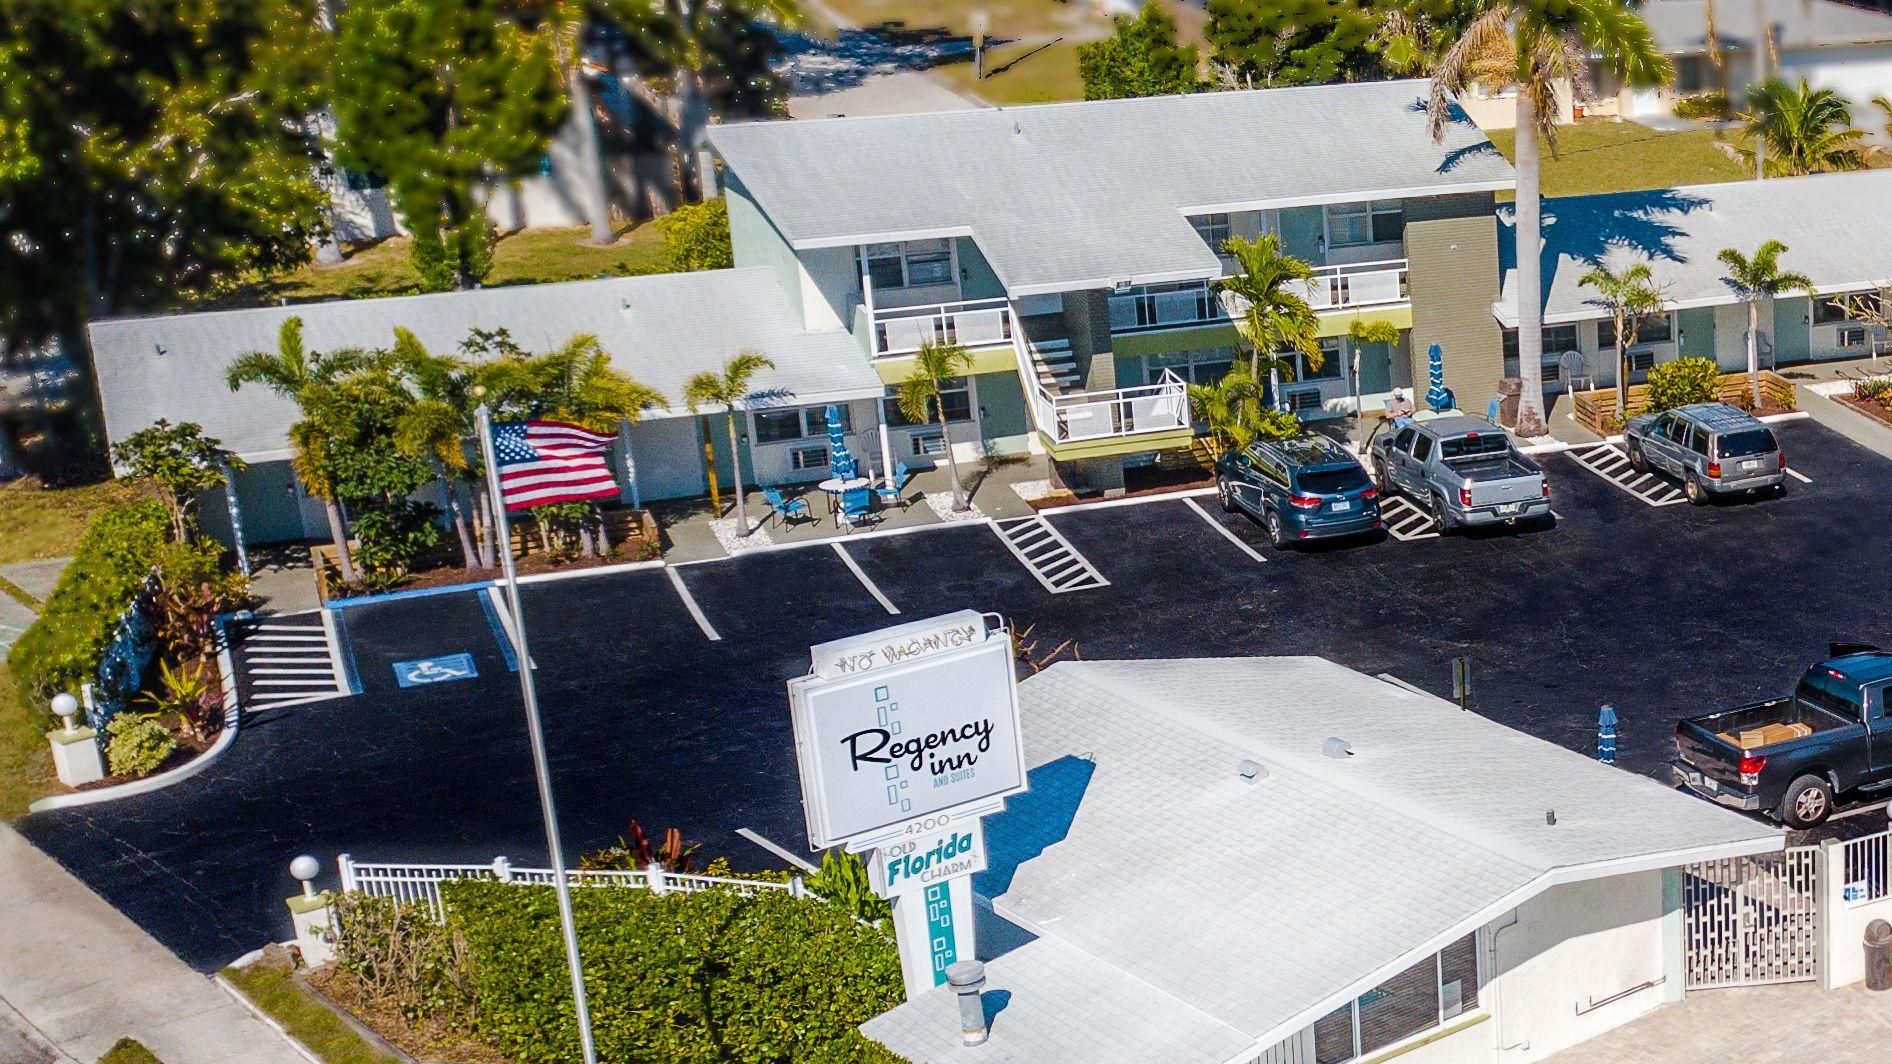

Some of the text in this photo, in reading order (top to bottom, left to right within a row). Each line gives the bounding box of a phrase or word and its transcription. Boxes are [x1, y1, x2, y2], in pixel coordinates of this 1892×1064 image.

[835, 625, 976, 672] NO VACANCY
[840, 718, 994, 772] Regency
[929, 752, 978, 776] inn
[933, 768, 976, 788] AND SUITES
[905, 814, 949, 834] 4200
[888, 832, 972, 886] Florida
[890, 841, 917, 857] OLD
[920, 859, 973, 882] CHARM
